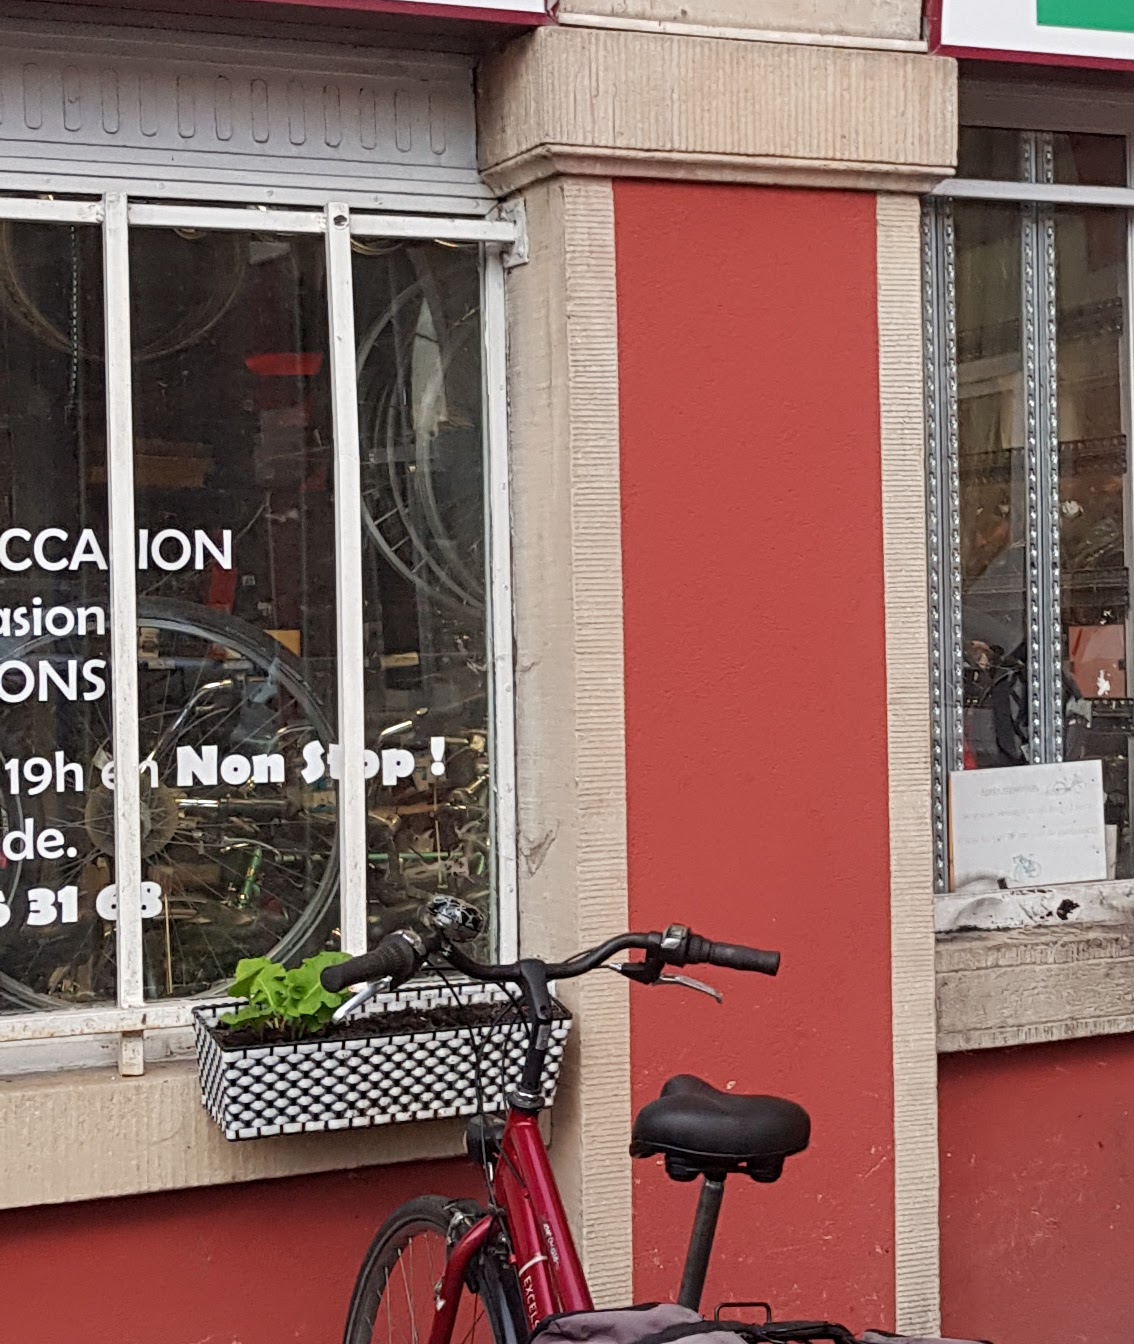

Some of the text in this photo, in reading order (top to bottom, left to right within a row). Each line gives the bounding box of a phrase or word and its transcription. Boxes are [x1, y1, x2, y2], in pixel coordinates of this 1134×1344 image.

[0, 528, 233, 572] CCAION
[0, 658, 108, 703] ONS
[4, 750, 84, 796] 19h
[176, 744, 286, 787] Non
[430, 736, 446, 777] !
[2, 817, 78, 862] de.
[26, 885, 79, 927] 31
